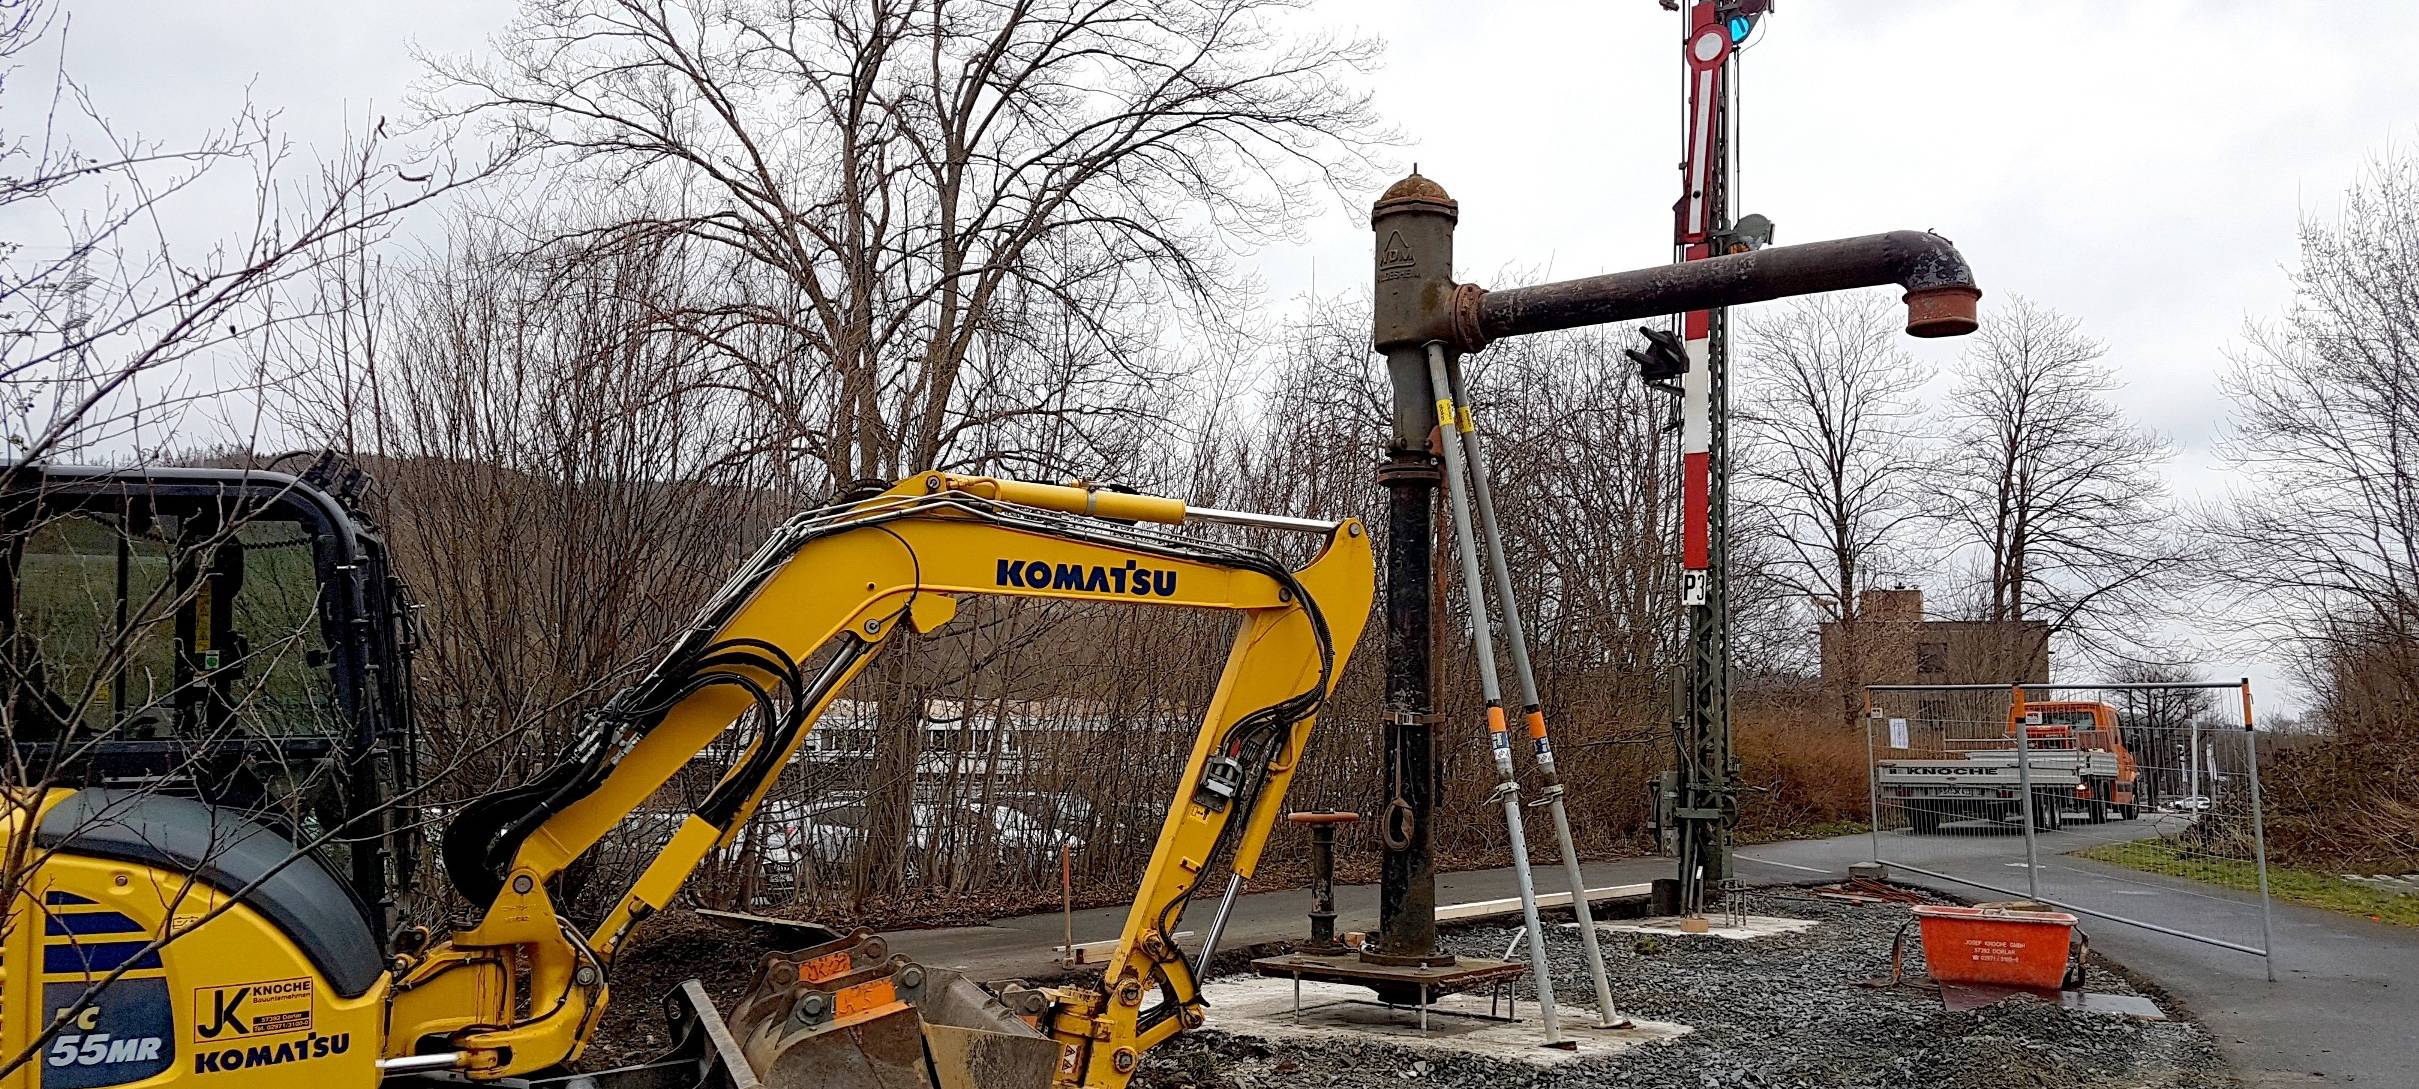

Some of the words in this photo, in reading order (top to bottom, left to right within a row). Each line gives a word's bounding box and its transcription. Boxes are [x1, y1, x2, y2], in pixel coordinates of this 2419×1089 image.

[996, 559, 1177, 596] KOMATSU
[1683, 574, 1705, 601] P3
[1906, 767, 1999, 775] KNOCHE
[253, 981, 311, 996] KNOCHE
[253, 992, 310, 1004] Bauunternehmen
[197, 987, 251, 1038] JK
[48, 1033, 161, 1067] 55MR
[194, 1032, 349, 1074] KOMATSU
